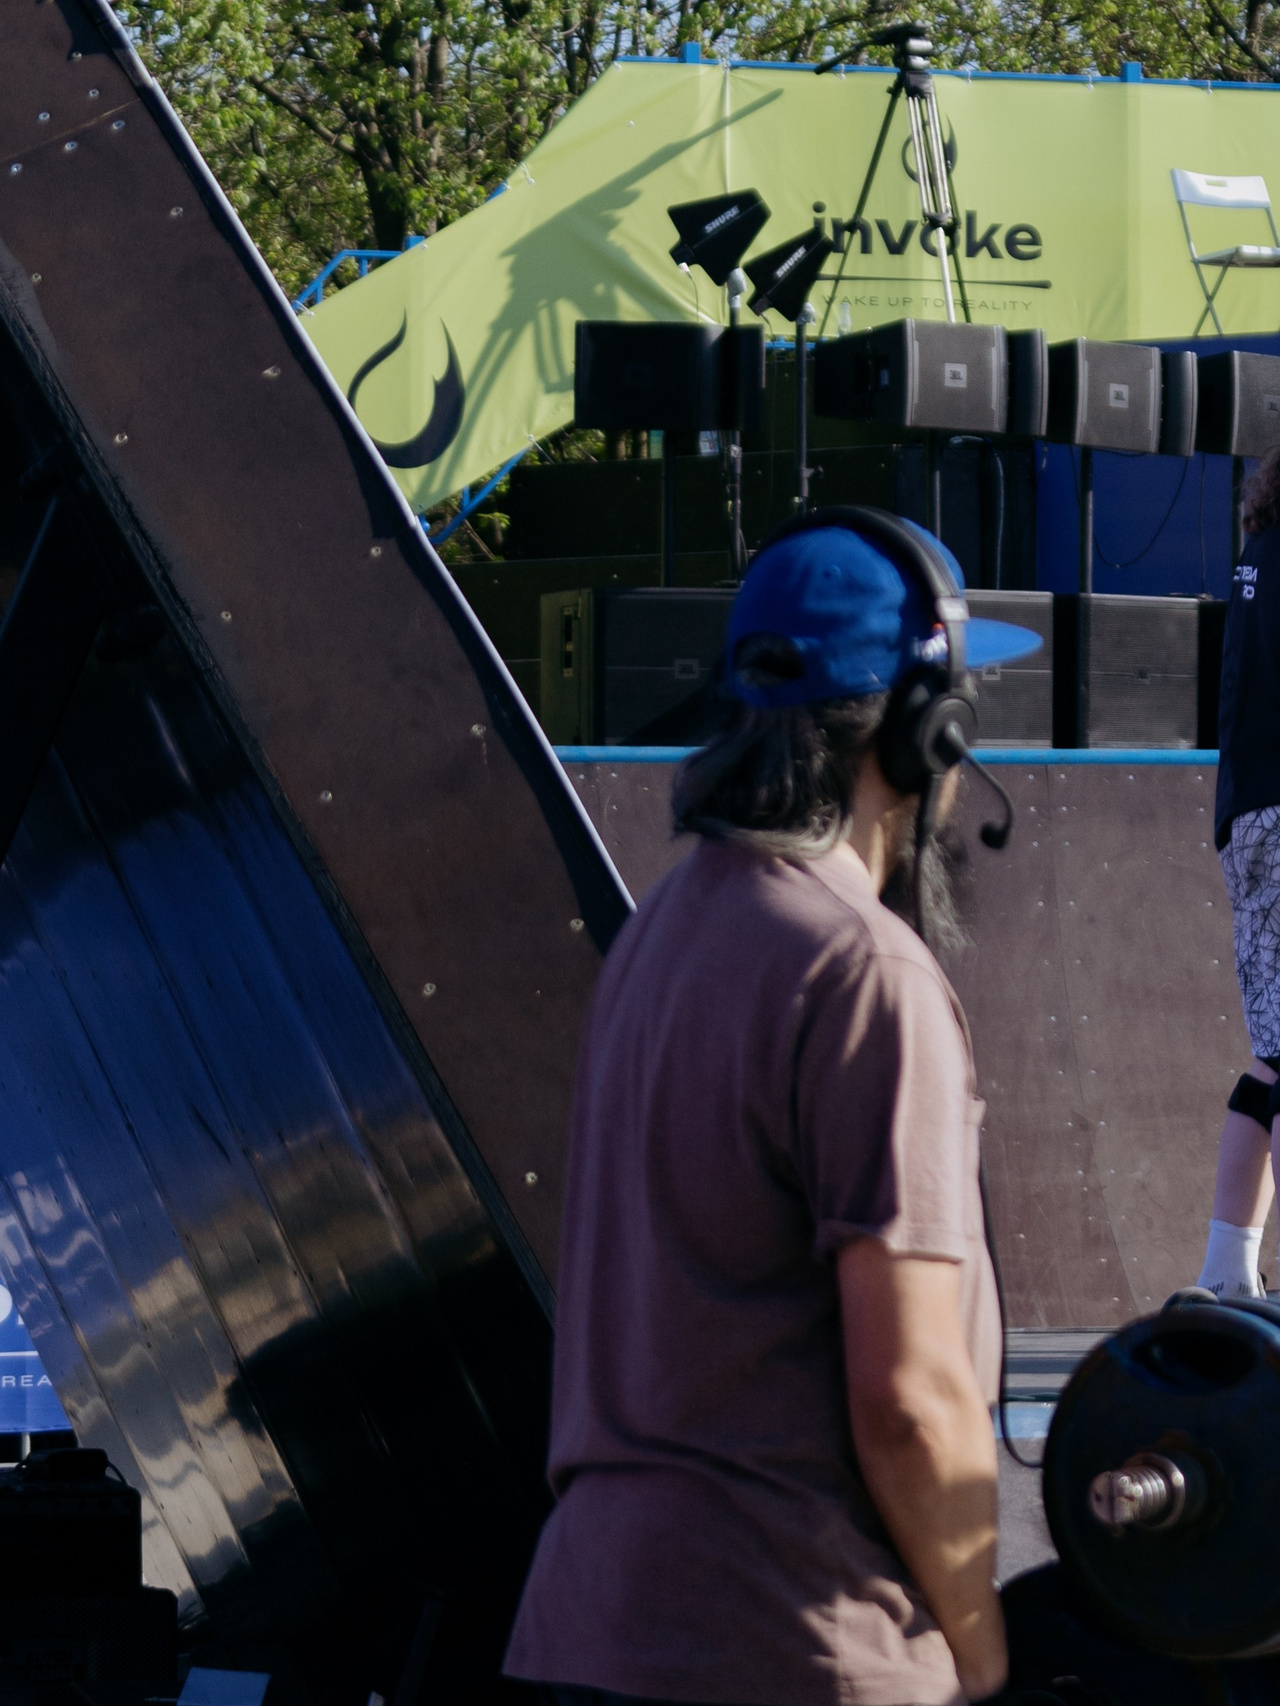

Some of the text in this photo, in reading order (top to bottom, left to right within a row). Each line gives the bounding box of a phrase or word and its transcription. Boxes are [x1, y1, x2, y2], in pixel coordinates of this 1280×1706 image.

[705, 205, 741, 234] SHURE
[812, 200, 1043, 261] invoke
[775, 244, 807, 278] SHURE
[821, 295, 1033, 311] WAKE UP TO REALITY
